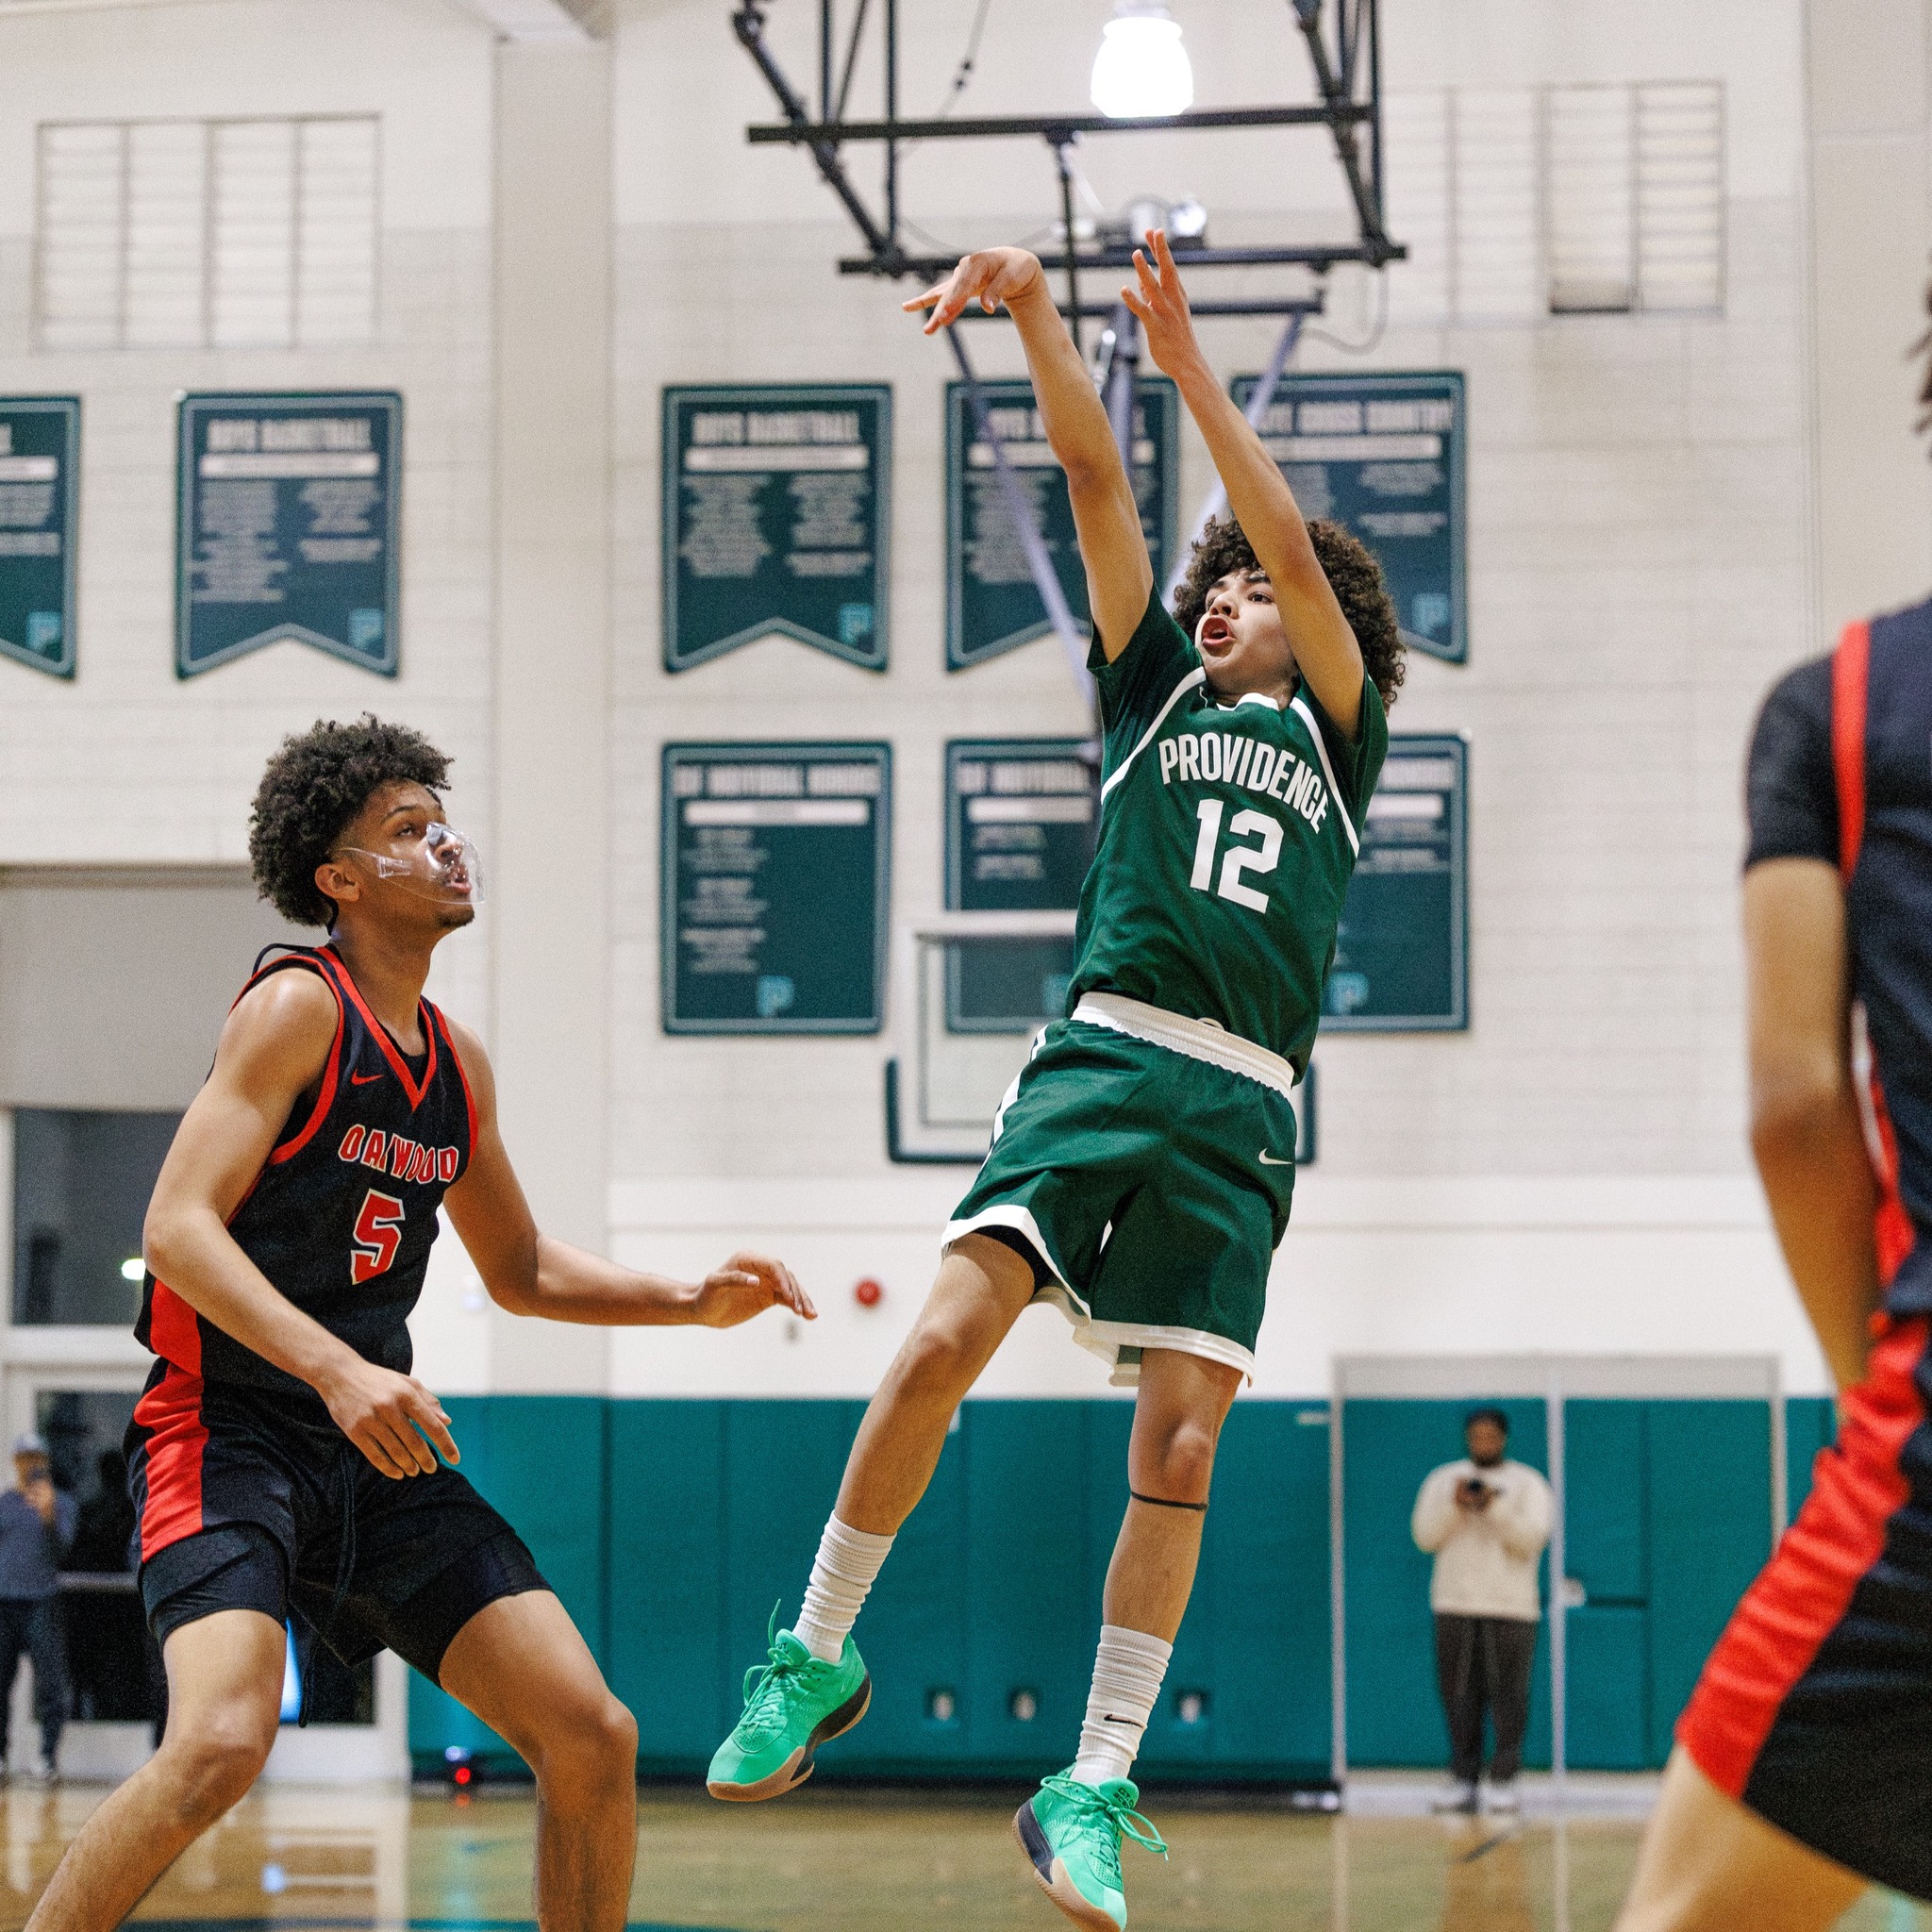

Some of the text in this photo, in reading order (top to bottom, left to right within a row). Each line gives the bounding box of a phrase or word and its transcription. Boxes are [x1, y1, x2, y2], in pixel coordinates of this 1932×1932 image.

[1158, 732, 1330, 835] PROVIDENCE
[1190, 798, 1284, 914] 12
[350, 1189, 407, 1286] 5
